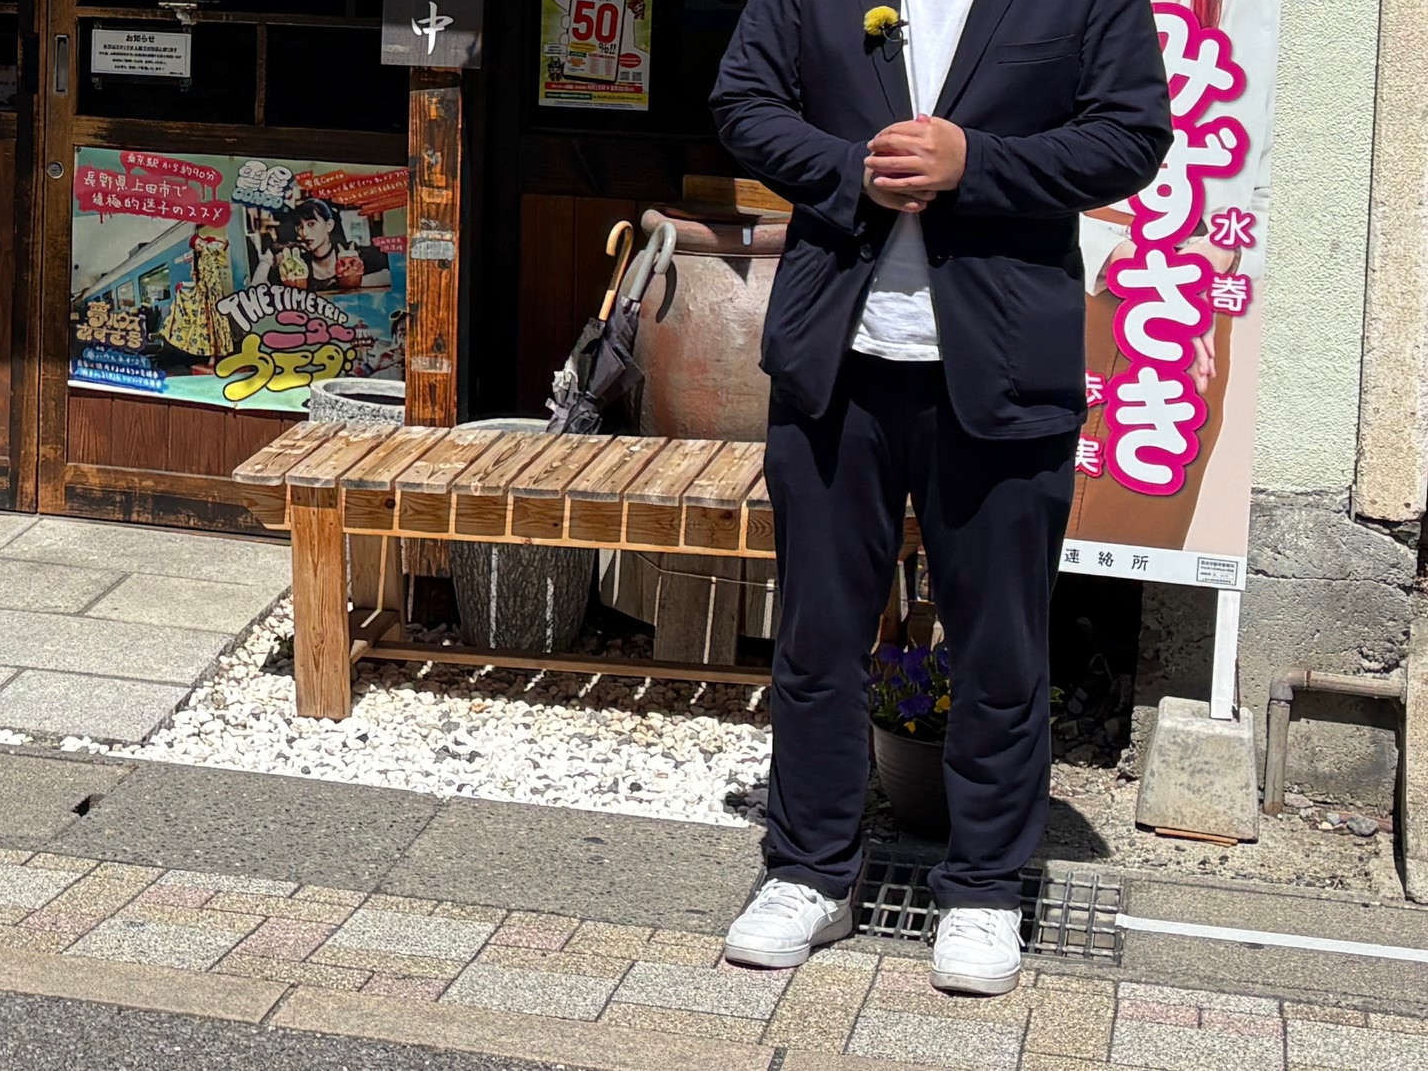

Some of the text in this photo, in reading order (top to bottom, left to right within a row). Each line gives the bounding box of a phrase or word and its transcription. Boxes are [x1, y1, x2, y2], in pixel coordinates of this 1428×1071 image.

[572, 0, 619, 44] 50
[83, 170, 188, 198] 長野県上田市で
[215, 283, 349, 332] THE TIME TRIP
[1063, 547, 1150, 572] 連絡所
